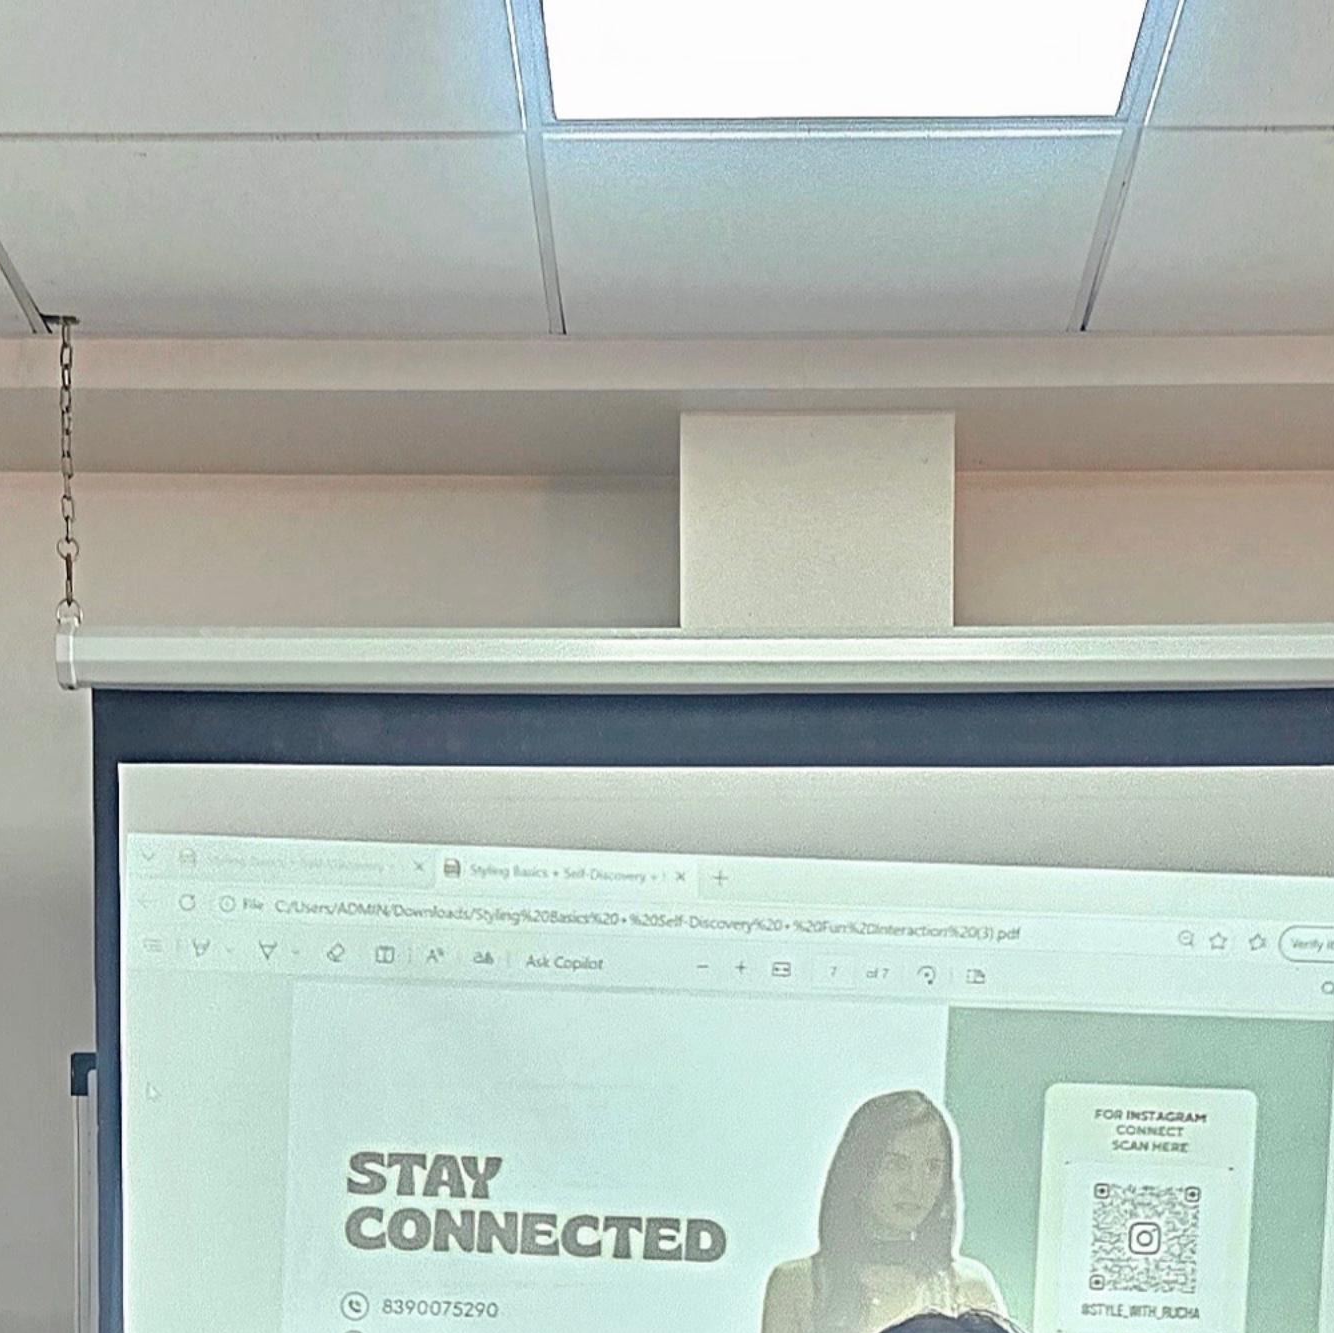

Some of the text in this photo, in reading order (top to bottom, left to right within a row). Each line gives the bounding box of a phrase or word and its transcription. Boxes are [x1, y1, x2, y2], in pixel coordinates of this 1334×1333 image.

[526, 955, 603, 971] Ask Copilot
[1094, 1109, 1207, 1123] FOR INSTAGRAM
[1116, 1124, 1184, 1137] CONNECT
[1112, 1140, 1189, 1153] SCAN HERE
[347, 1151, 502, 1199] STAY
[345, 1206, 727, 1262] CONNECTED
[382, 1299, 499, 1318] 8390075290
